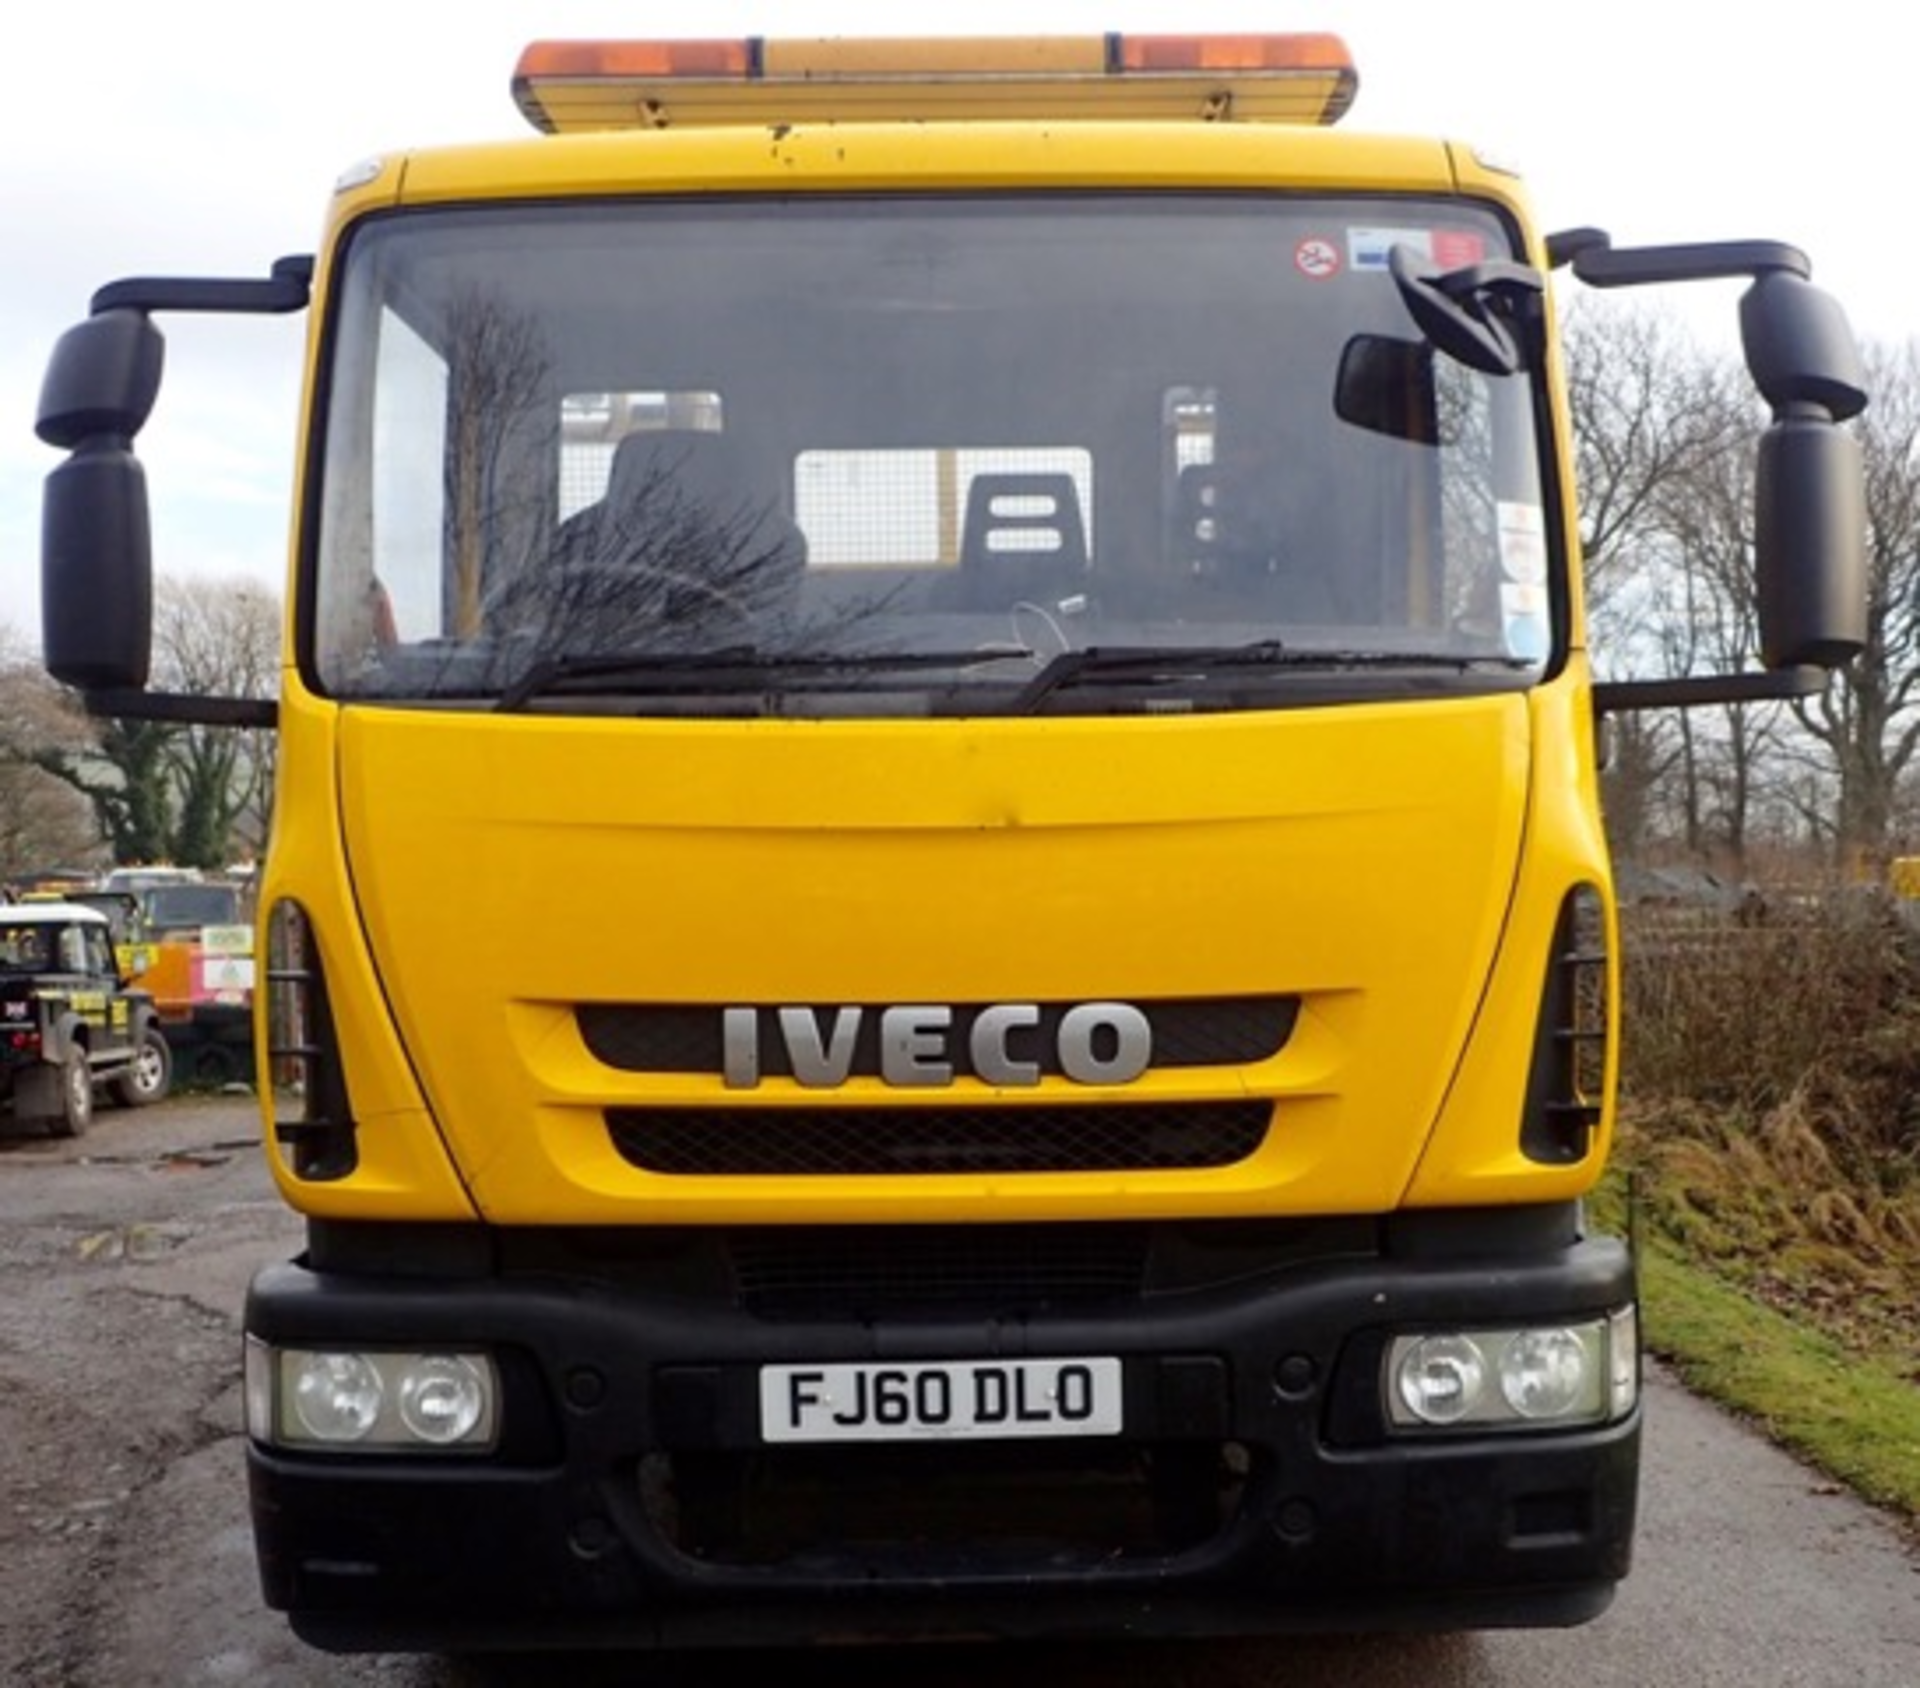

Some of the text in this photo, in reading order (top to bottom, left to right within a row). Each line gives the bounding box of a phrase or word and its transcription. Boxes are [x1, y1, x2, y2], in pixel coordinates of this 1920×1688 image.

[723, 1002, 1152, 1089] IVECO
[789, 1365, 1093, 1427] FJ60 DLO
